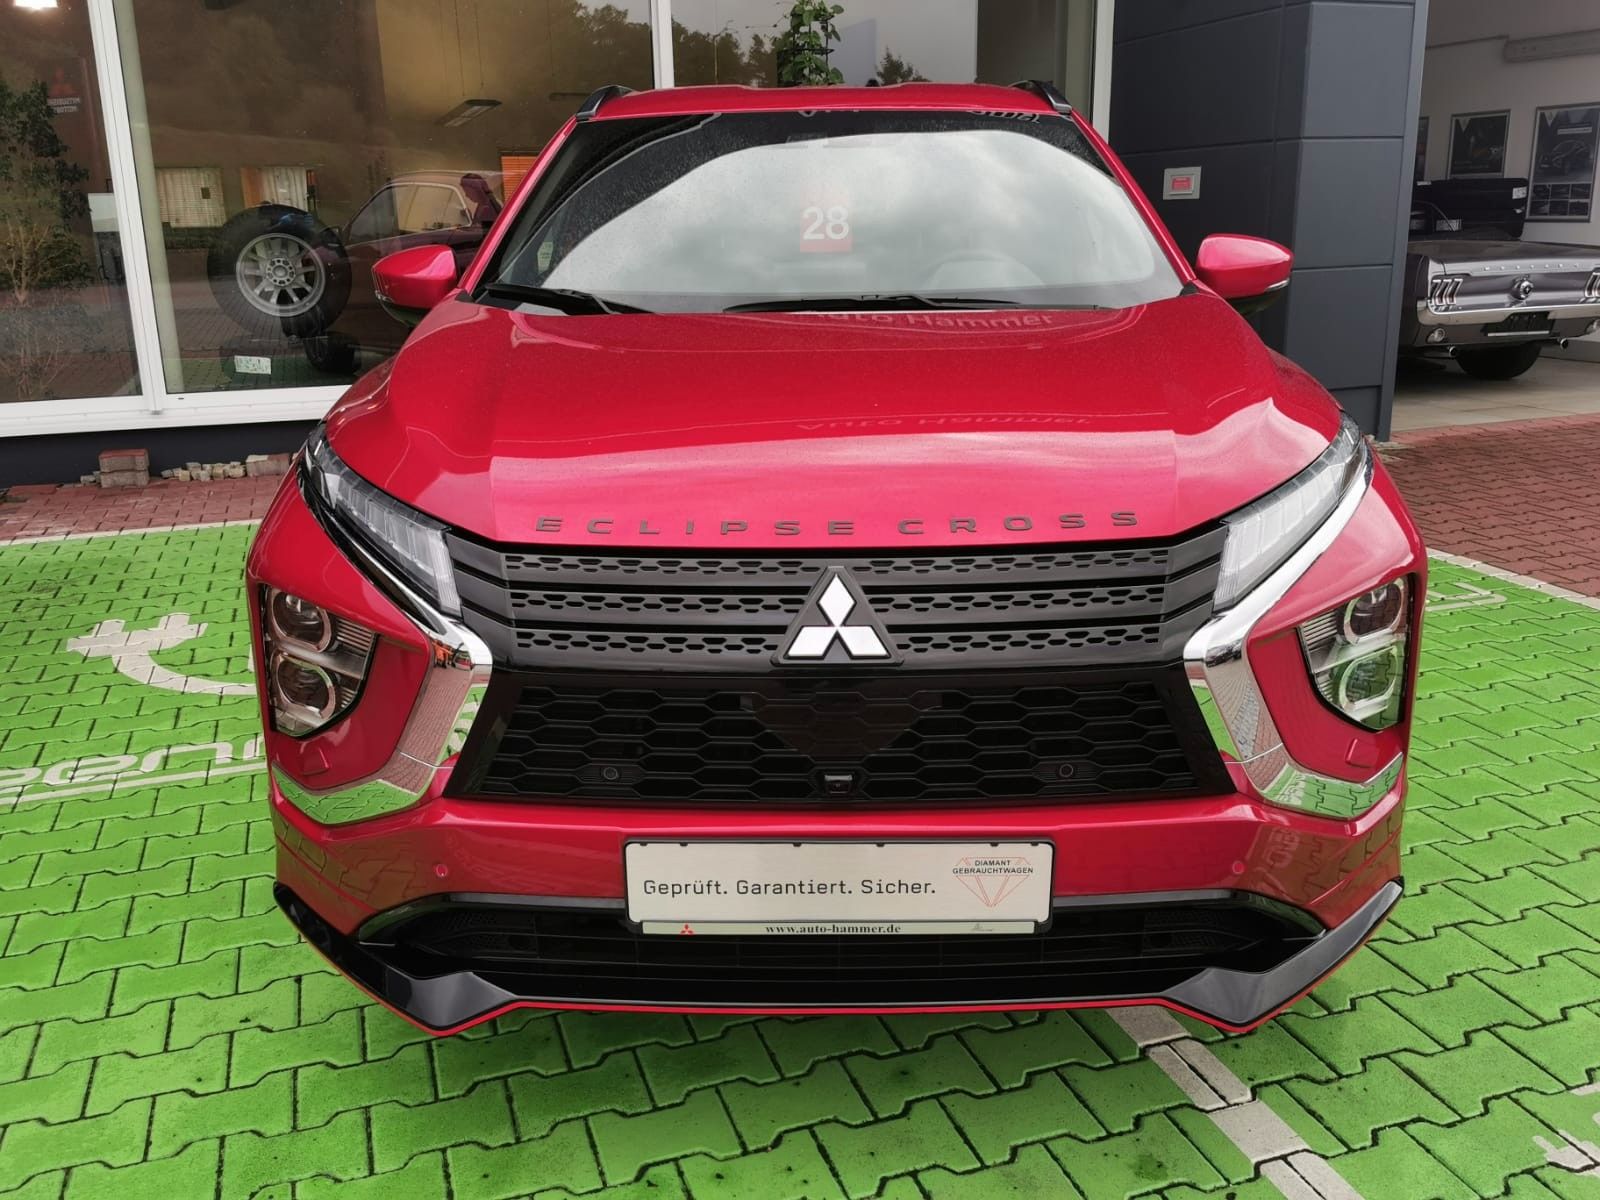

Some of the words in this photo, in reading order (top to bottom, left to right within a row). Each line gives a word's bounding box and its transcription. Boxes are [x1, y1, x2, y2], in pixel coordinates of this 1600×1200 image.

[802, 206, 850, 240] 28
[536, 516, 854, 535] ECLIPSE
[897, 511, 1138, 535] CROSS
[974, 859, 1011, 867] DIAMANT
[952, 867, 1034, 875] GEBRAUCHTWAGEN
[643, 879, 728, 898] Geprüft.
[736, 879, 853, 895] Garantiert.
[861, 879, 936, 894] Sicher.
[765, 923, 901, 934] www.auto-hammer.de
